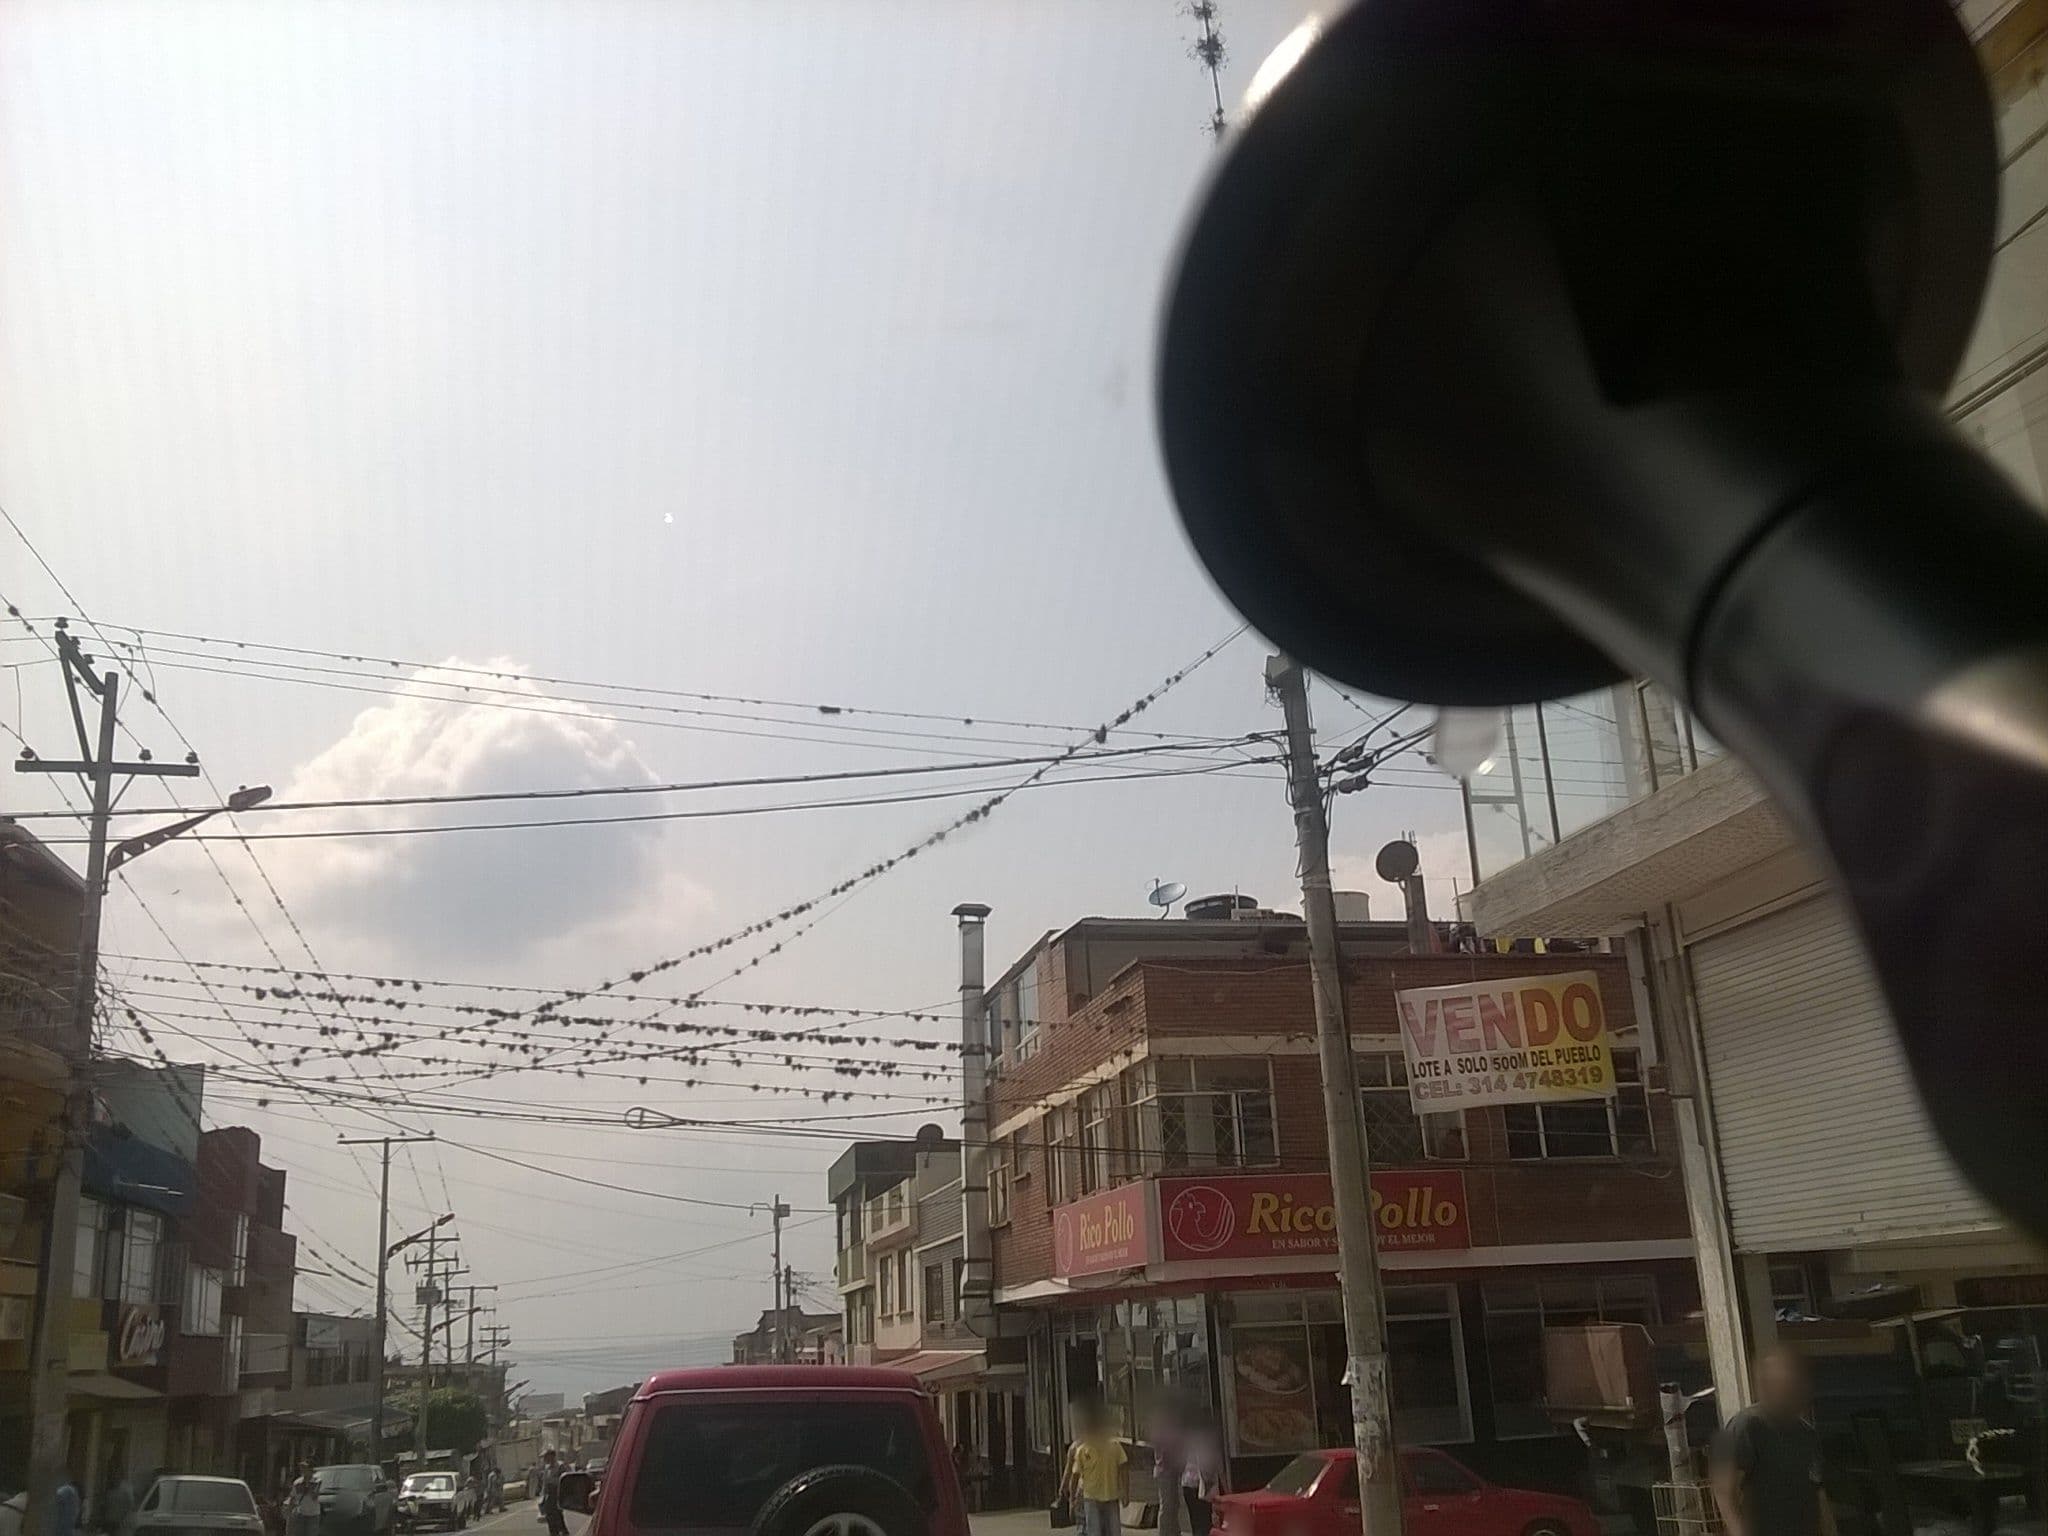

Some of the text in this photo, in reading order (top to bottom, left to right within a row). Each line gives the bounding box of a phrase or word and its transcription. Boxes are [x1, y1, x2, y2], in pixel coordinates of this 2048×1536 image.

[1400, 983, 1600, 1057] VENDO
[1412, 1045, 1600, 1078] LOTE A SOLO 500M DEL PUEBLO
[1415, 1080, 1463, 1099] CEL:
[1468, 1073, 1507, 1094] 314
[1080, 1200, 1134, 1251] Rico Pollo
[1246, 1192, 1337, 1234] Rico
[1272, 1239, 1286, 1249] EN
[1287, 1238, 1321, 1249] SABOR
[1402, 1232, 1436, 1245] MEJOR
